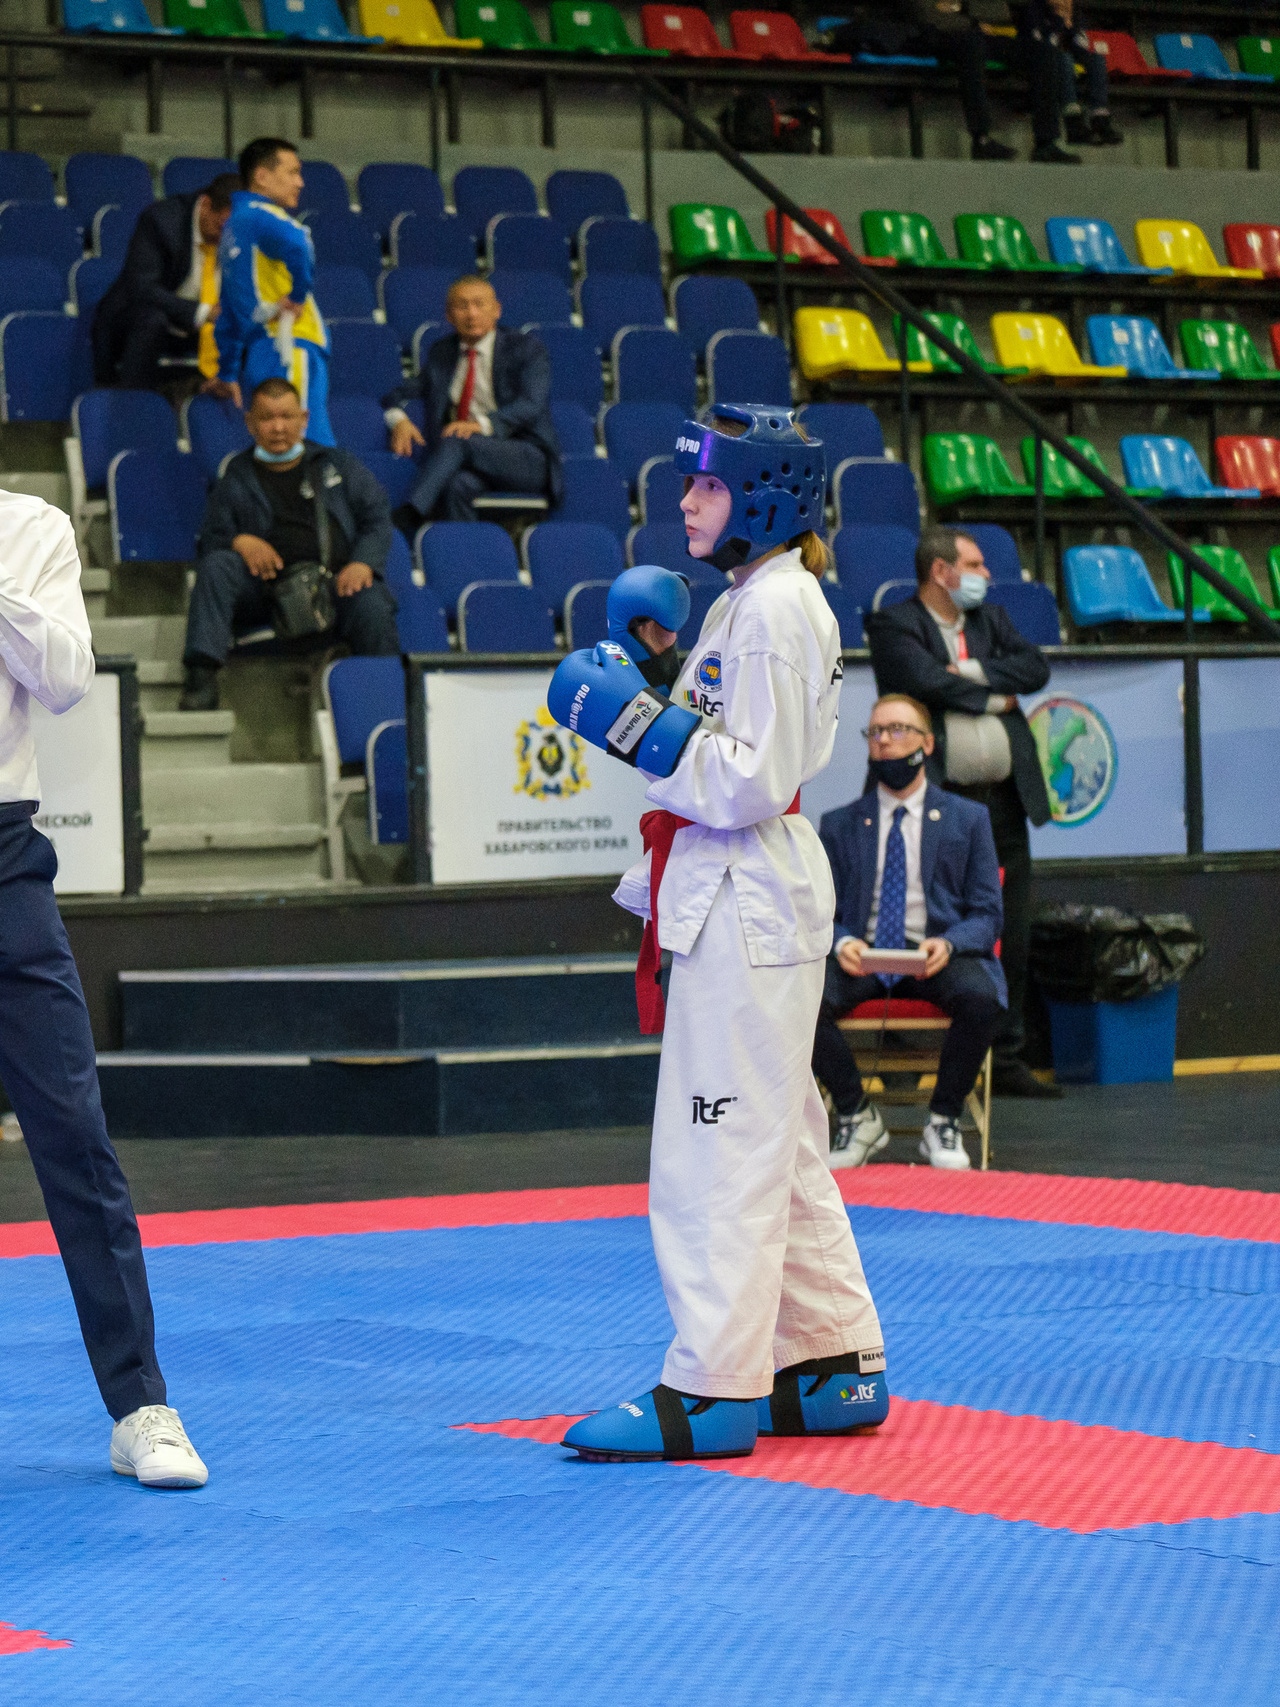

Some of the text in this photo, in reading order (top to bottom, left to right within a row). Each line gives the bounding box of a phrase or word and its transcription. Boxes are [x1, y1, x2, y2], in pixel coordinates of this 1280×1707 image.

[615, 730, 629, 745] MAX
[628, 713, 642, 728] PRO
[497, 816, 612, 833] ПРАВИТЕЛЬСТВО
[485, 835, 629, 856] ХАБАРОВСКОГО КРАЯ
